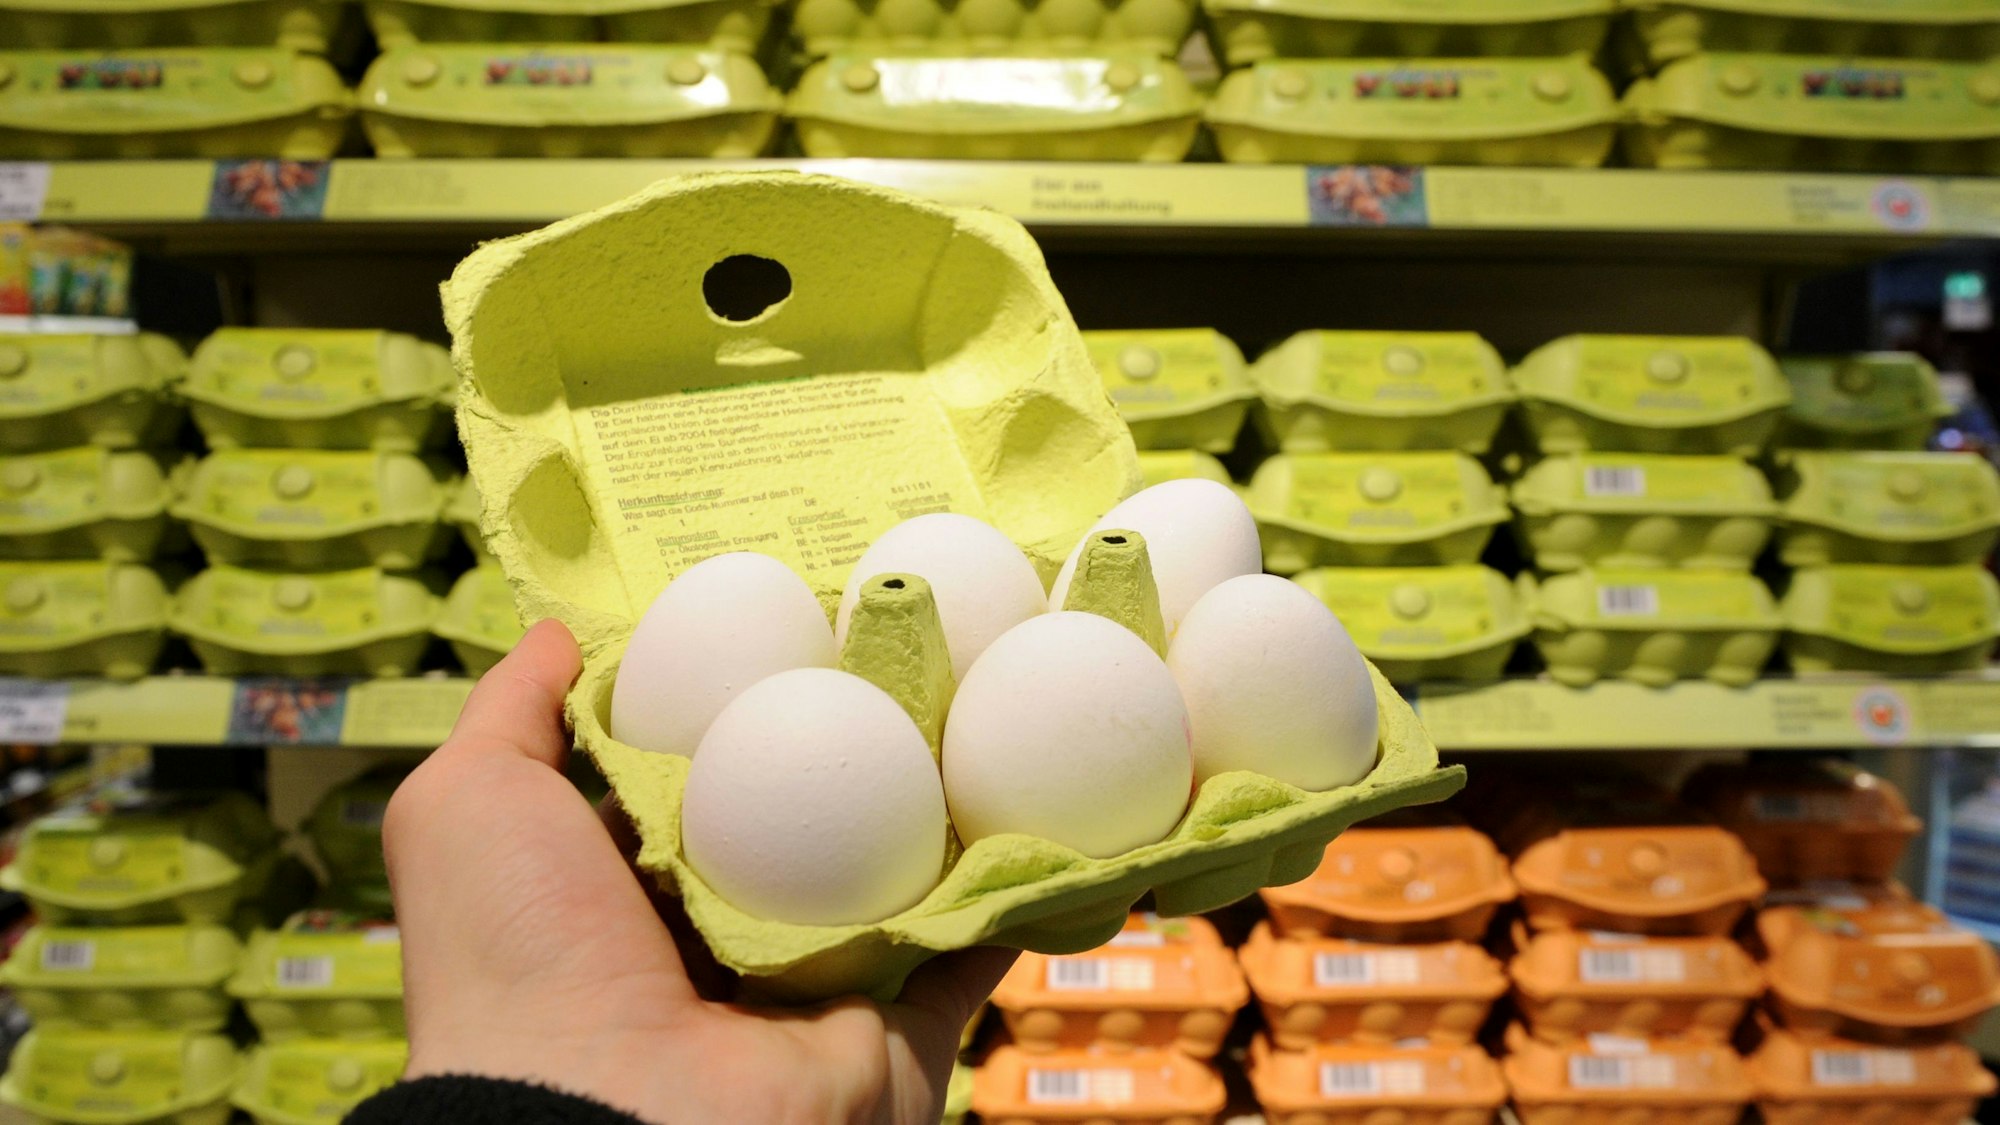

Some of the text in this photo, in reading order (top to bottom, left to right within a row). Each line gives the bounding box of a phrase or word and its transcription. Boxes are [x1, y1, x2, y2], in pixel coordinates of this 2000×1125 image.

[591, 409, 610, 418] Die
[595, 420, 609, 430] für
[613, 416, 633, 426] Eier
[636, 411, 670, 424] haben
[673, 409, 695, 418] eine
[698, 401, 749, 416] Änderung
[598, 424, 666, 441] Europäische
[669, 416, 700, 430] Union
[703, 415, 719, 425] die
[602, 440, 619, 451] auf
[623, 438, 647, 449] dem
[650, 435, 660, 445] Ei
[664, 432, 678, 442] ab
[680, 429, 706, 441] 2004
[605, 451, 624, 462] Der
[628, 443, 693, 462] Empfehlung
[696, 440, 716, 450] des
[608, 461, 645, 474] schutz
[649, 459, 665, 471] zur
[668, 455, 699, 468] Folge
[703, 451, 724, 462] wird
[727, 448, 741, 459] ab
[744, 444, 767, 455] dem
[612, 472, 640, 485] nach
[644, 470, 661, 481] der
[664, 467, 698, 479] neuen
[700, 455, 782, 474] Kennzeichnung
[618, 486, 725, 510] Herkunftssicherung:
[622, 510, 643, 521] Was
[646, 507, 666, 519] sagt
[668, 504, 683, 515] die
[752, 492, 767, 503] auf
[769, 489, 789, 500] dem
[804, 498, 817, 507] DE
[816, 516, 868, 532] Deutschland
[656, 529, 720, 547] Haltungsform
[733, 530, 779, 546] Erzeugung
[796, 538, 808, 548] BE
[820, 531, 852, 544] Belgien
[801, 549, 814, 560] FR
[825, 540, 870, 556] Frankreich
[805, 562, 818, 572] NL
